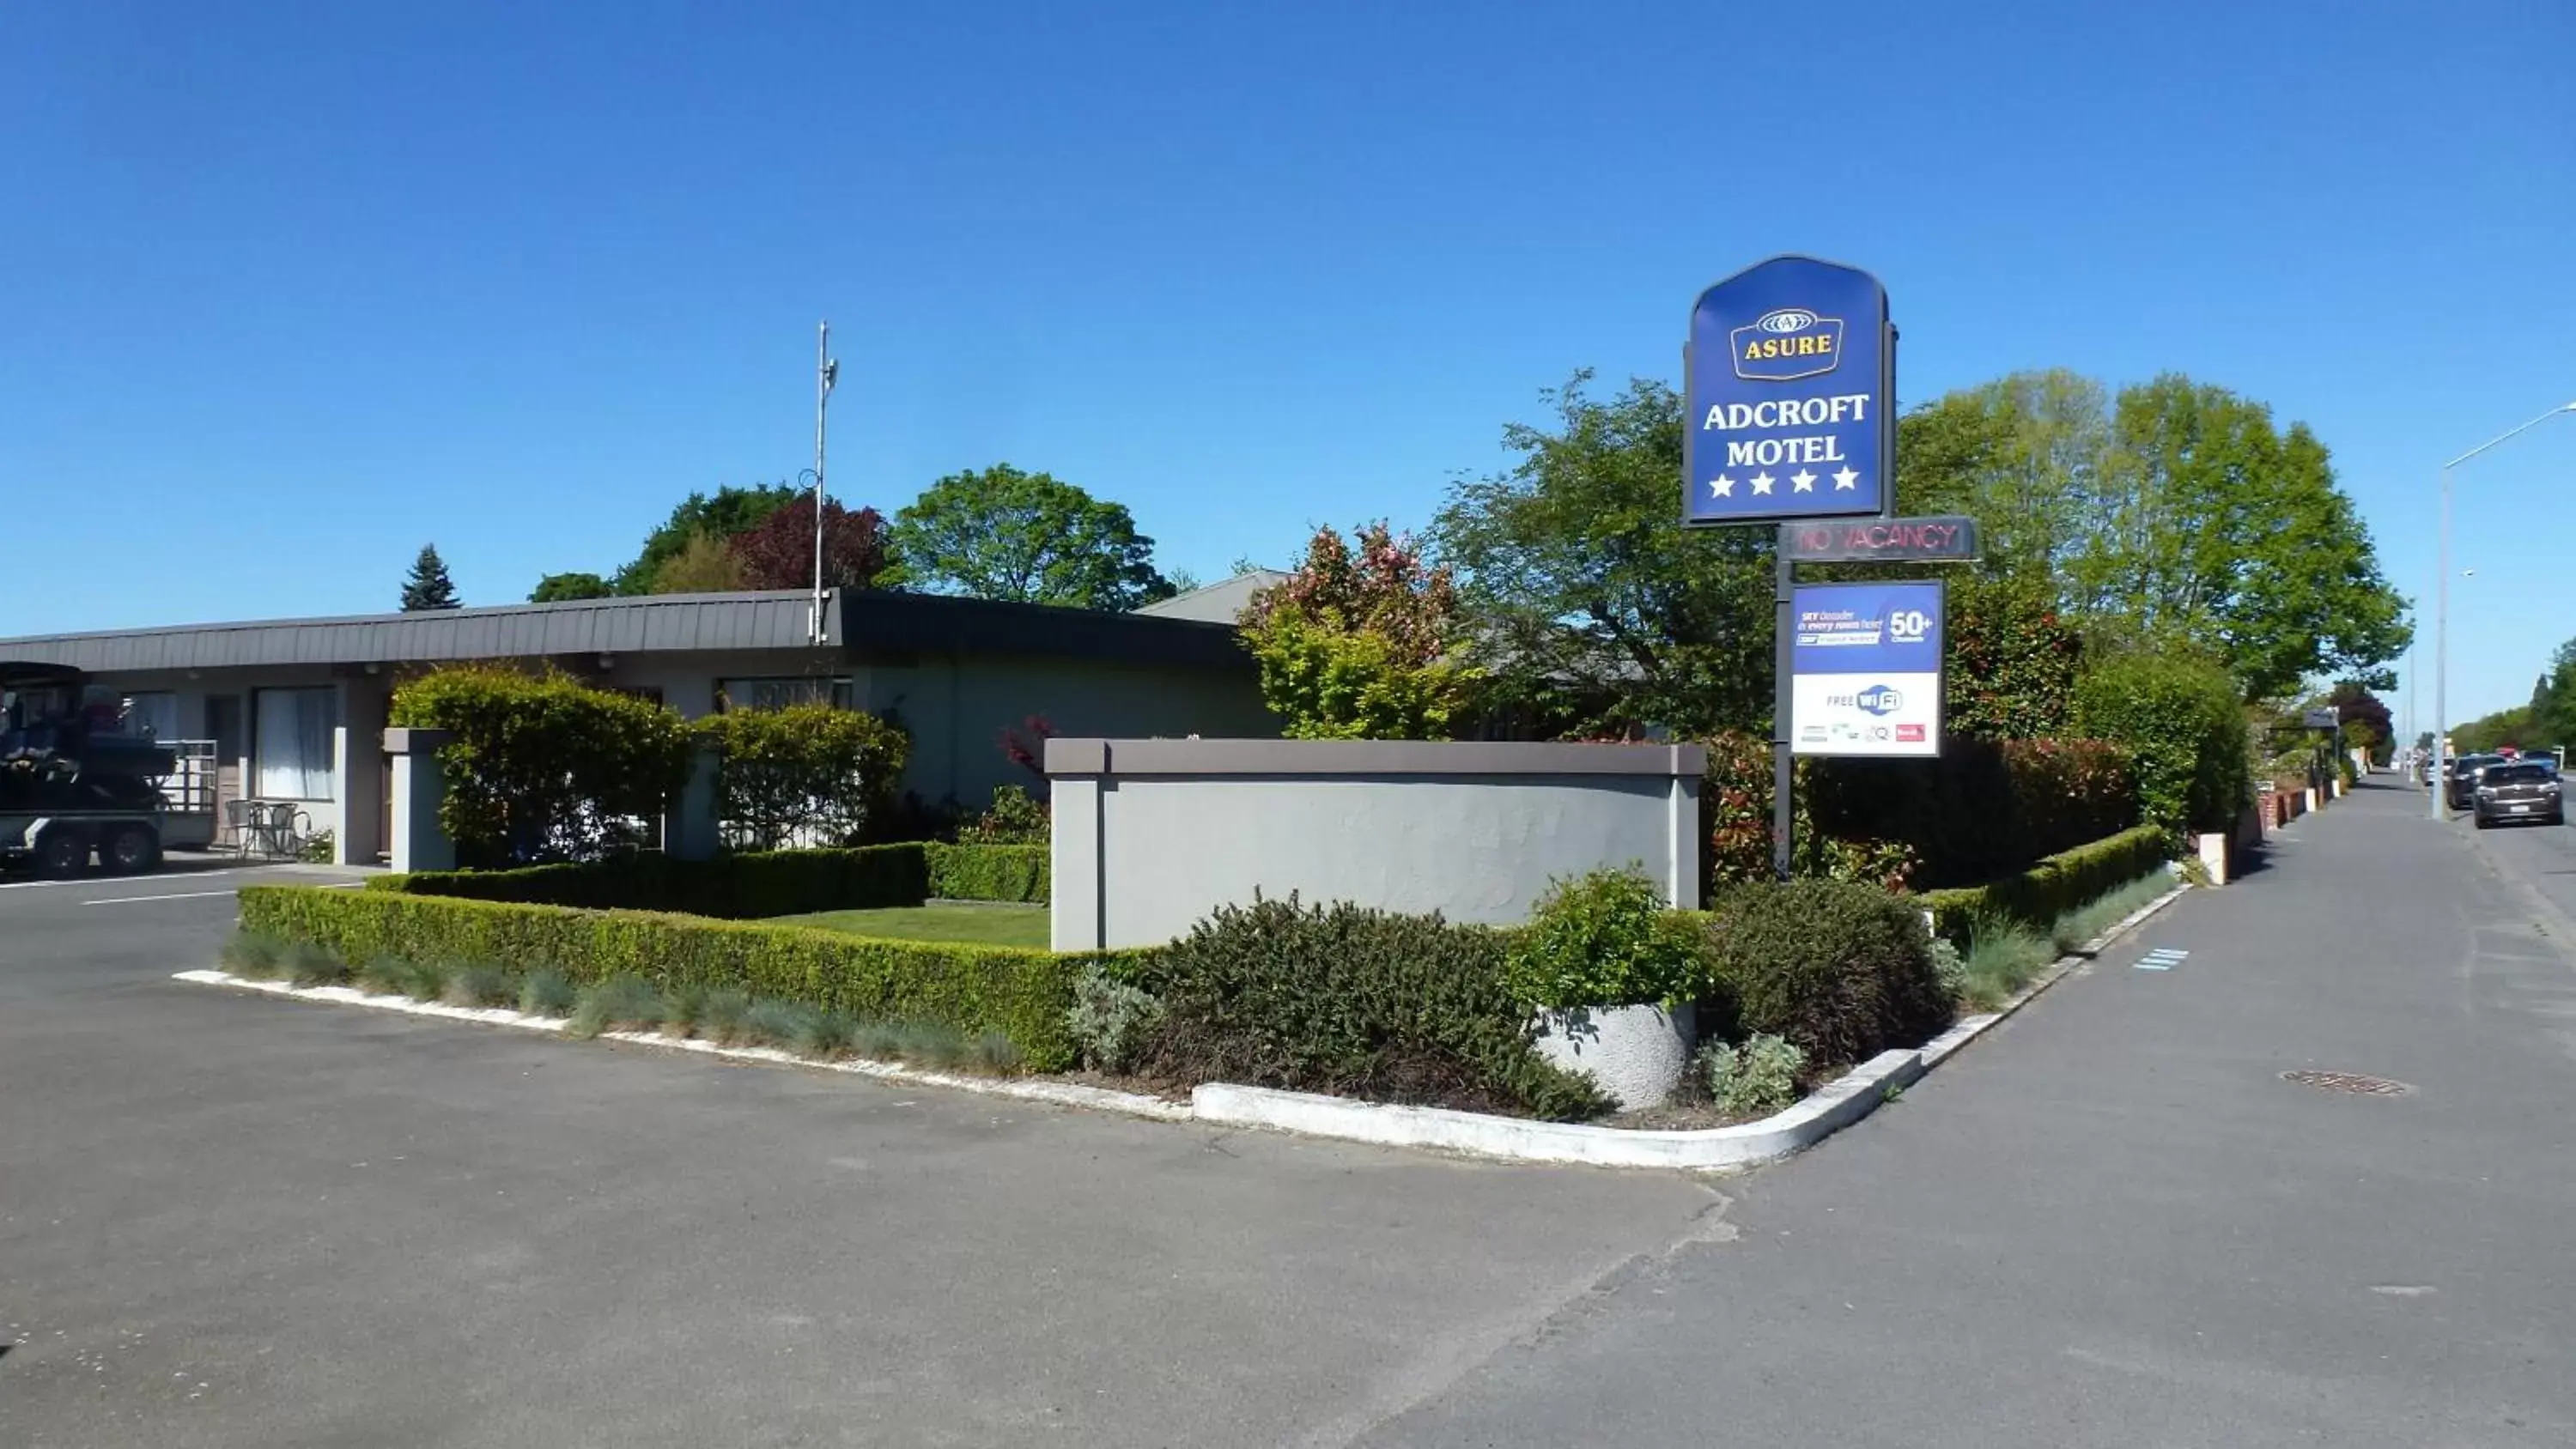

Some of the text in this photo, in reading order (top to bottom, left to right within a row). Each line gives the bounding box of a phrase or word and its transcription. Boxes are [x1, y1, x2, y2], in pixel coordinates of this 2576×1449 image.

[1745, 334, 1832, 360] ASURE
[1704, 394, 1869, 430] ADCROFT
[1727, 436, 1844, 467] MOTEL
[1799, 524, 1958, 550] NO VACANCY
[1890, 611, 1933, 636] 50+
[1826, 695, 1854, 706] FREE
